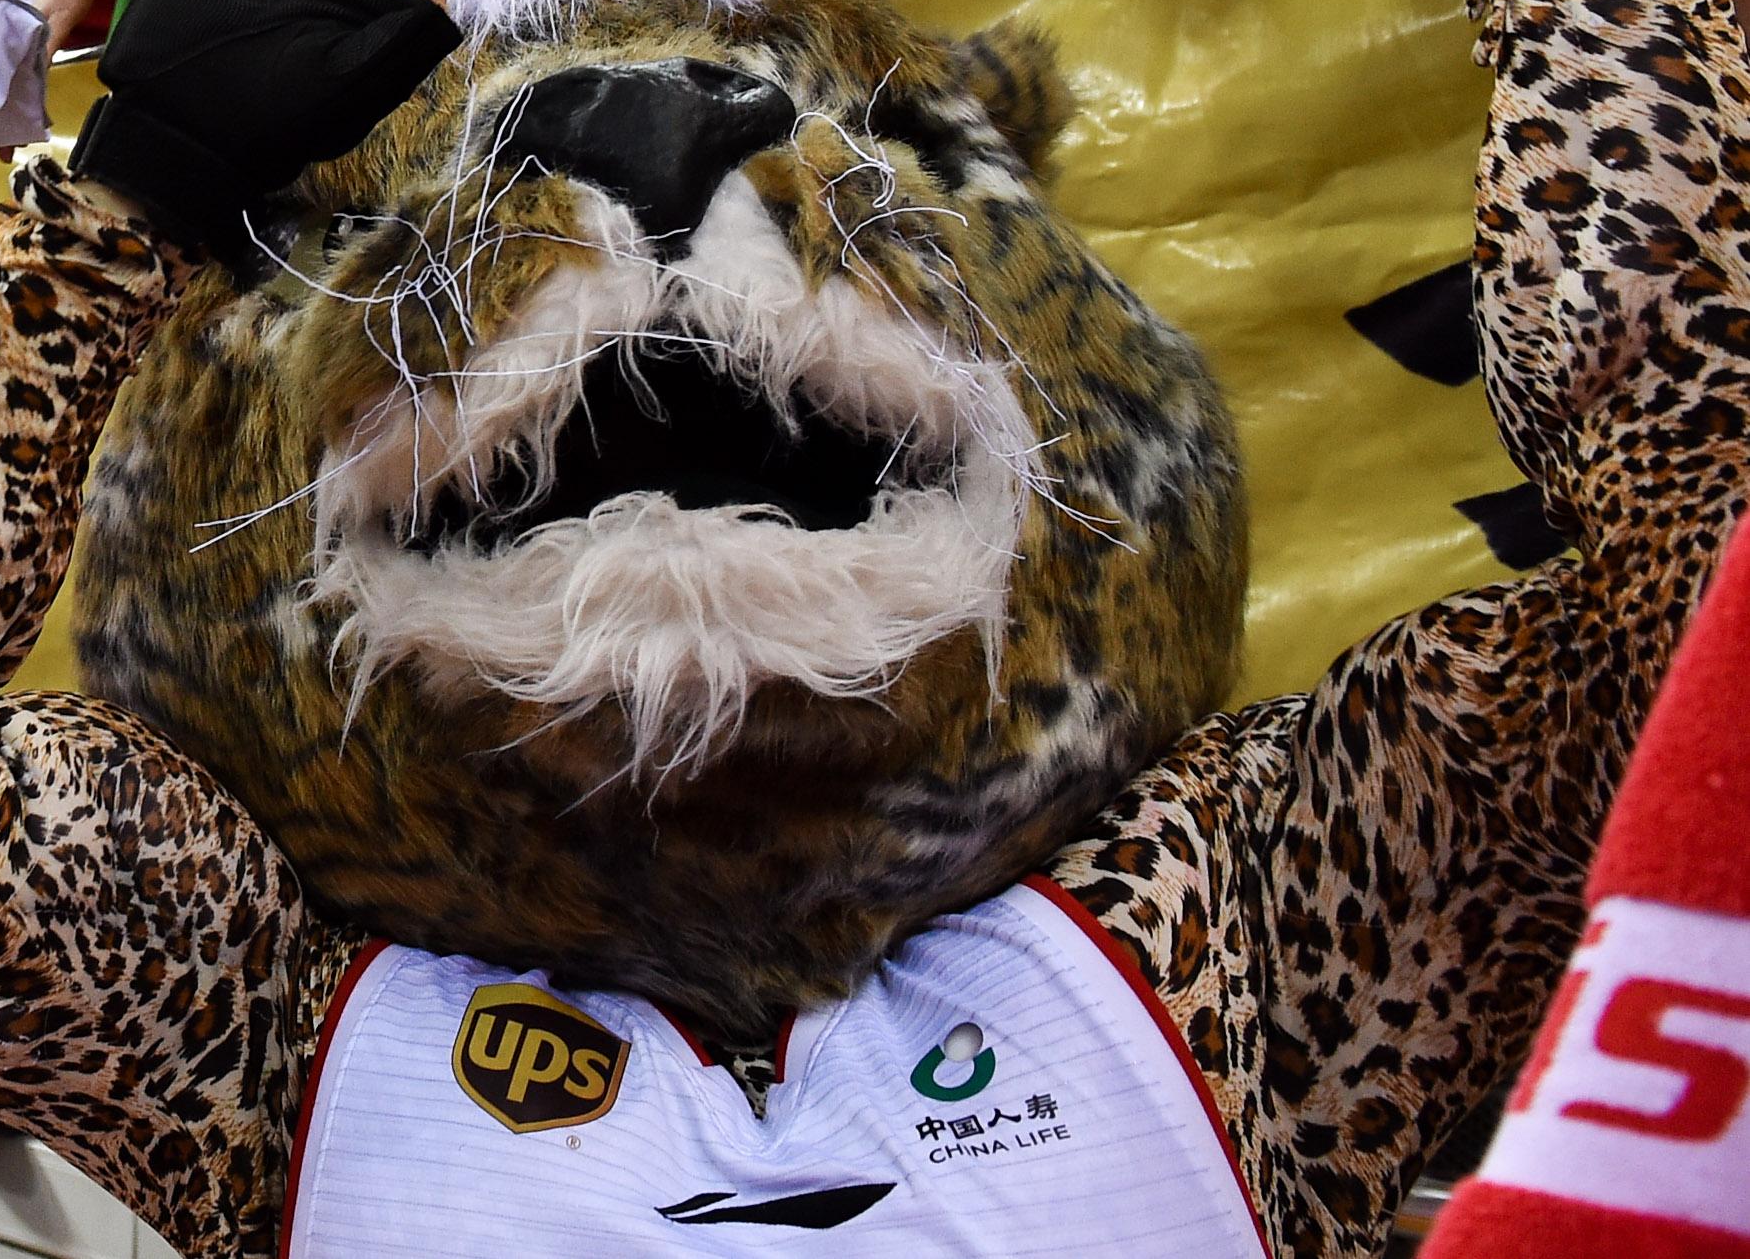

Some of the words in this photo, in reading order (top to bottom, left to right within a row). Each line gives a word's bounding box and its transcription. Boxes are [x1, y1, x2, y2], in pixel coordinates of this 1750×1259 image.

[468, 1012, 611, 1103] ups
[915, 1093, 1059, 1141] 中国人寿
[928, 1140, 1010, 1164] CHINA
[1014, 1123, 1072, 1149] LIFE
